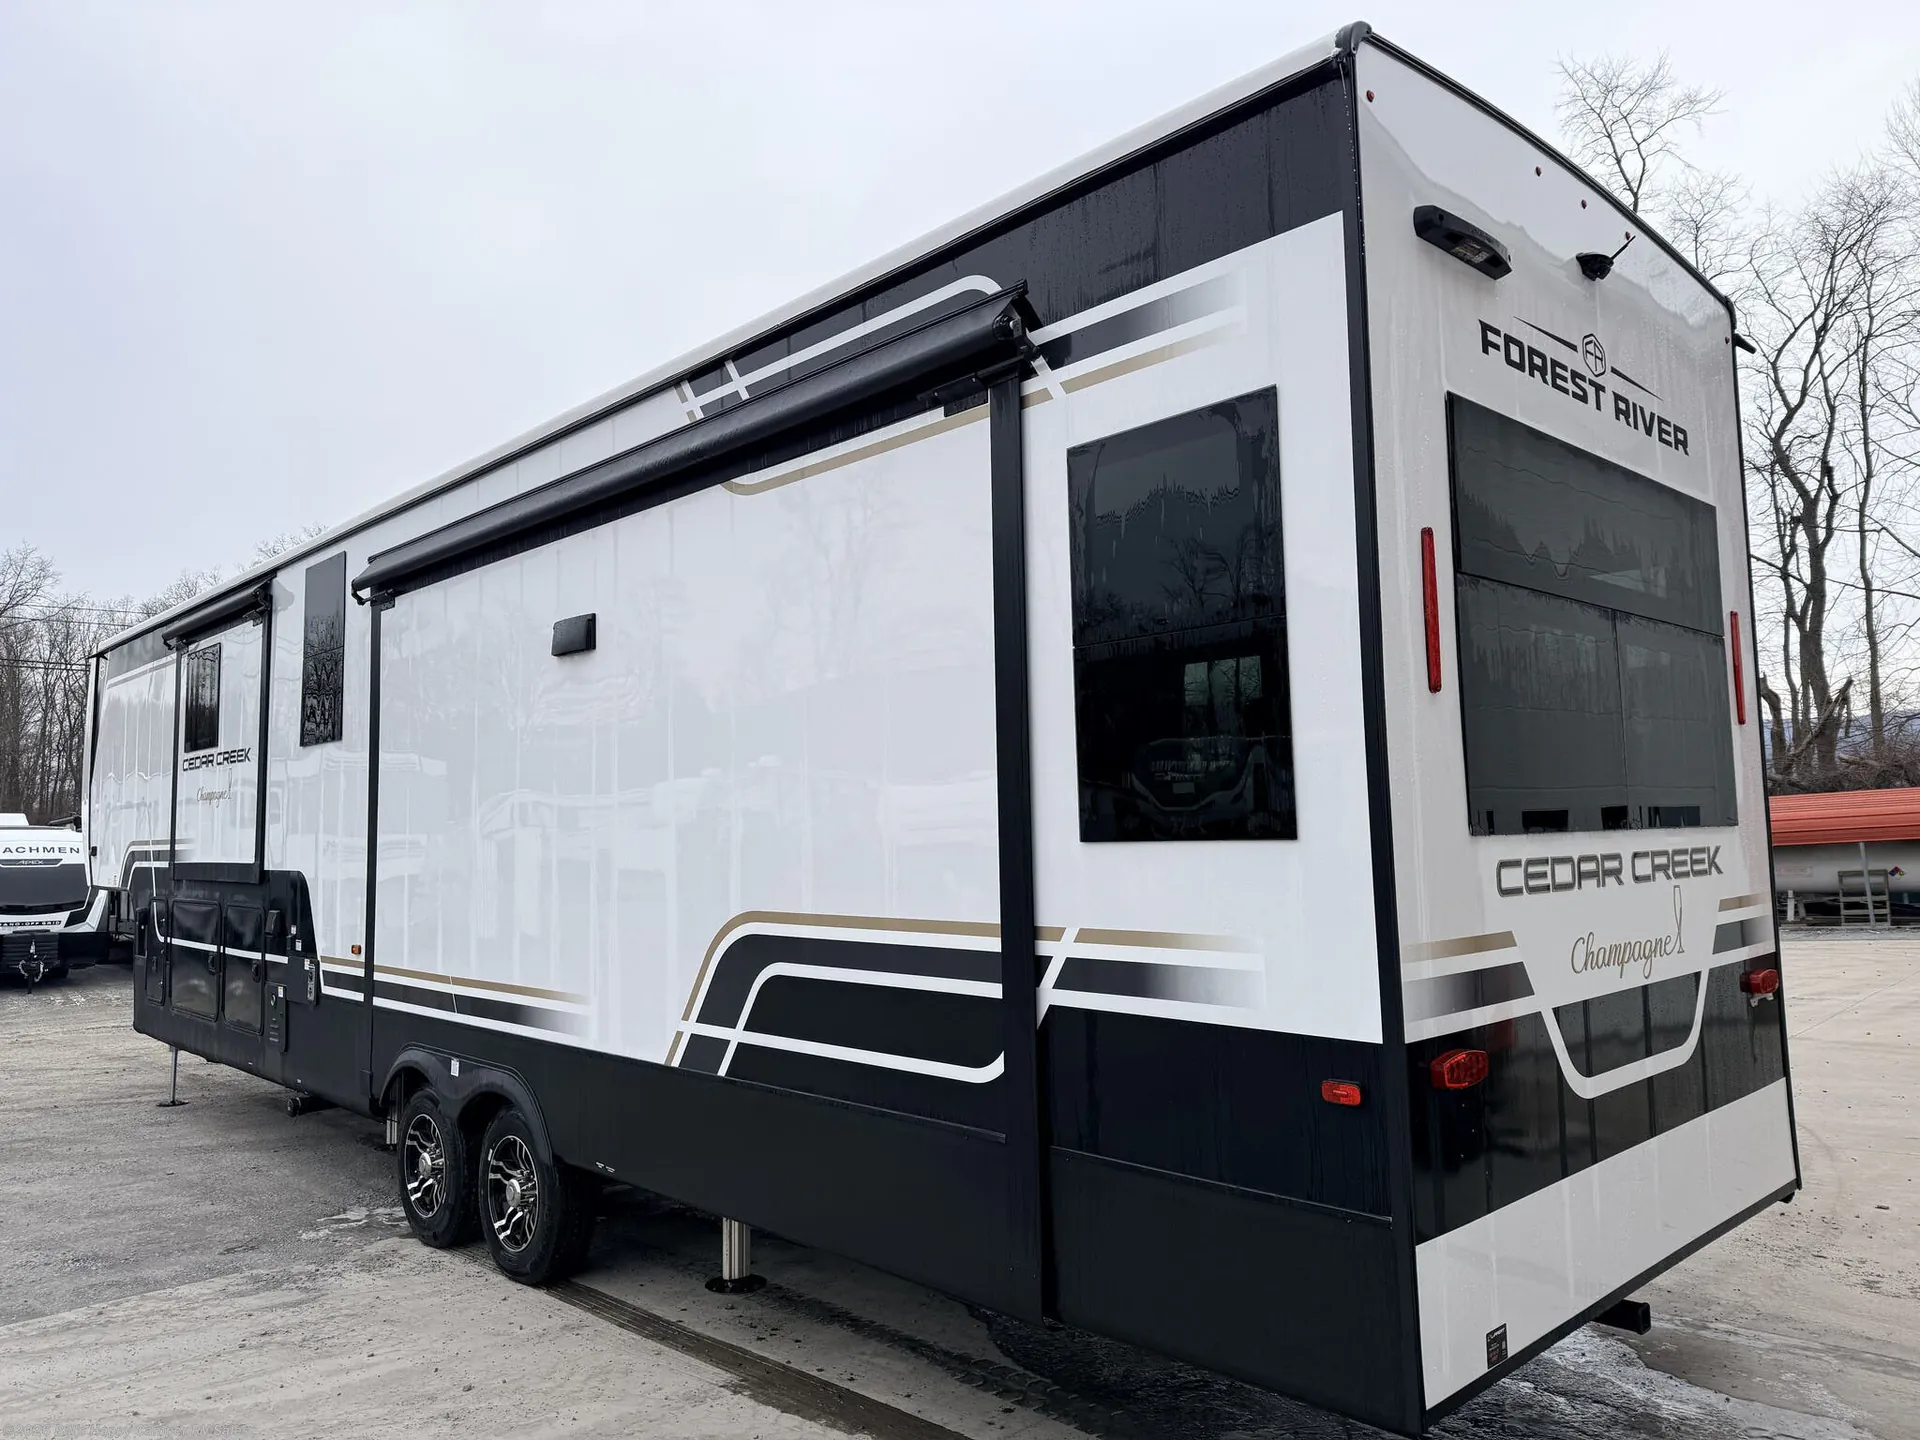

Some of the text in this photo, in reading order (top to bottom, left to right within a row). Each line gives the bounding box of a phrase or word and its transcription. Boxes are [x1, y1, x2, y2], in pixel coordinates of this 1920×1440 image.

[1478, 318, 1690, 456] FOREST RIVER
[183, 748, 251, 771] CEDAR CREEK
[1496, 845, 1724, 898] CEDAR CREEK
